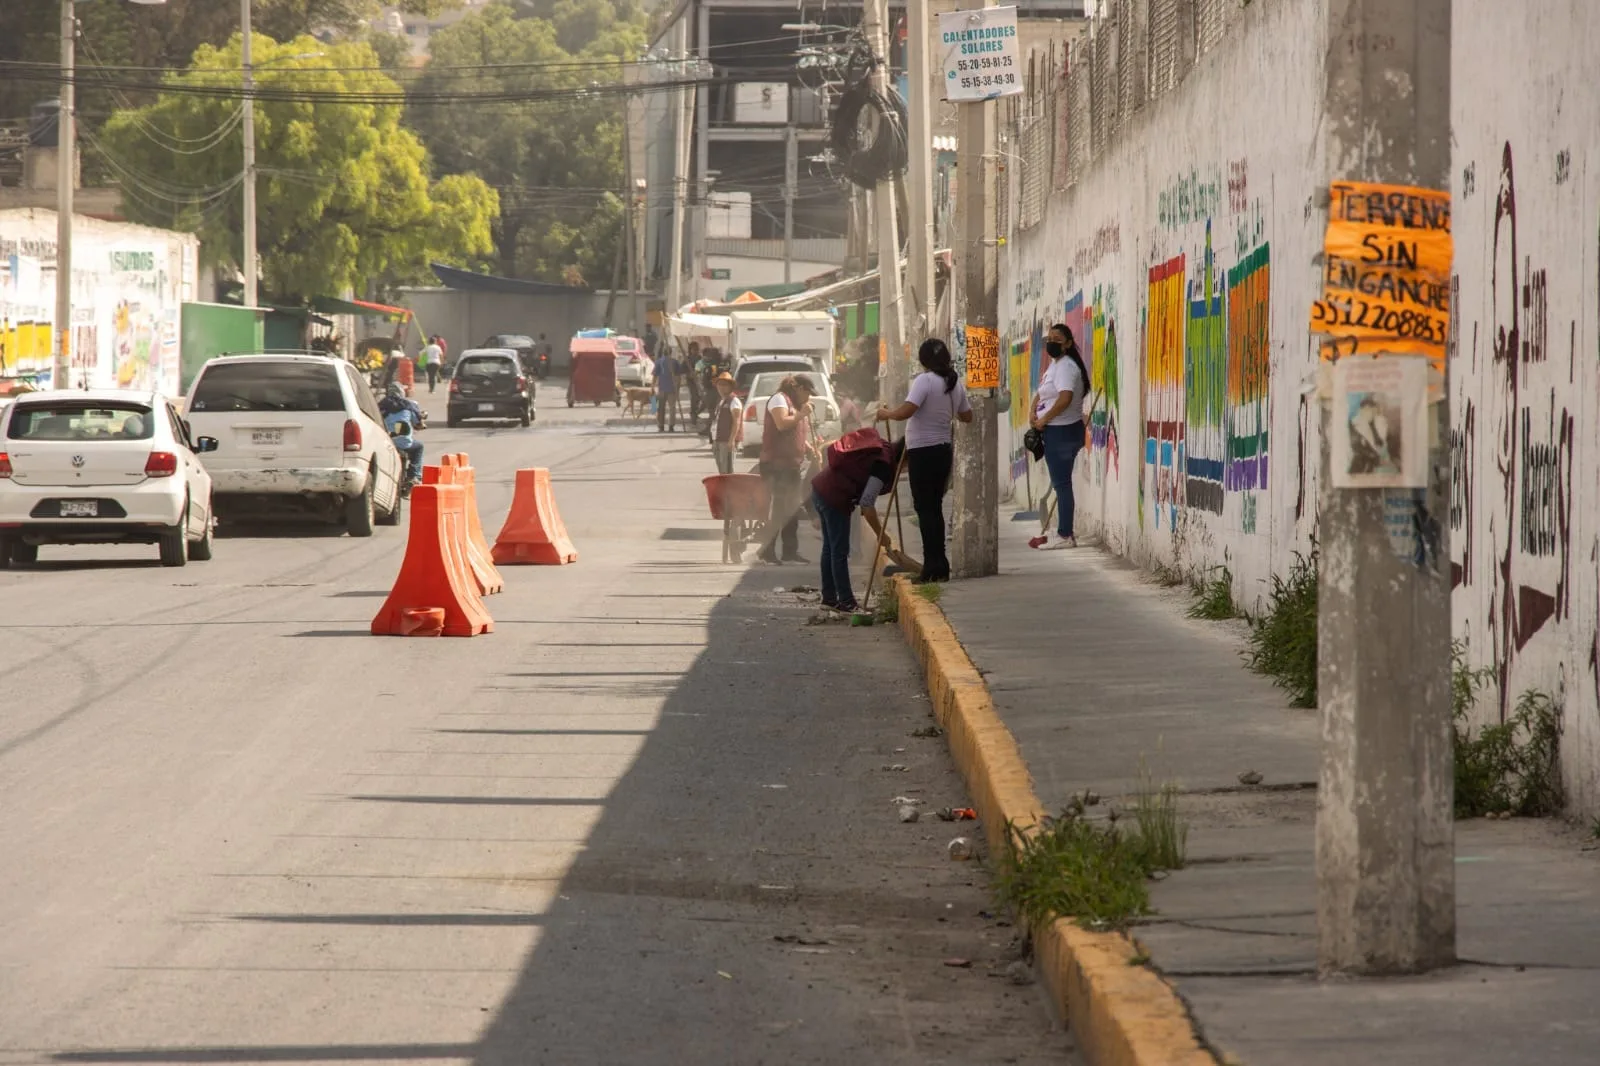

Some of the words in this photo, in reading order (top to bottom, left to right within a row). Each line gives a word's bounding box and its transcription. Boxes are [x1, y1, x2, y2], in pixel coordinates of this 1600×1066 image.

[943, 26, 1016, 43] CALENTADORES
[961, 41, 1003, 54] SOLARES
[958, 56, 1013, 71] 55-20-59-81-25
[1520, 386, 1557, 557] Marcelo
